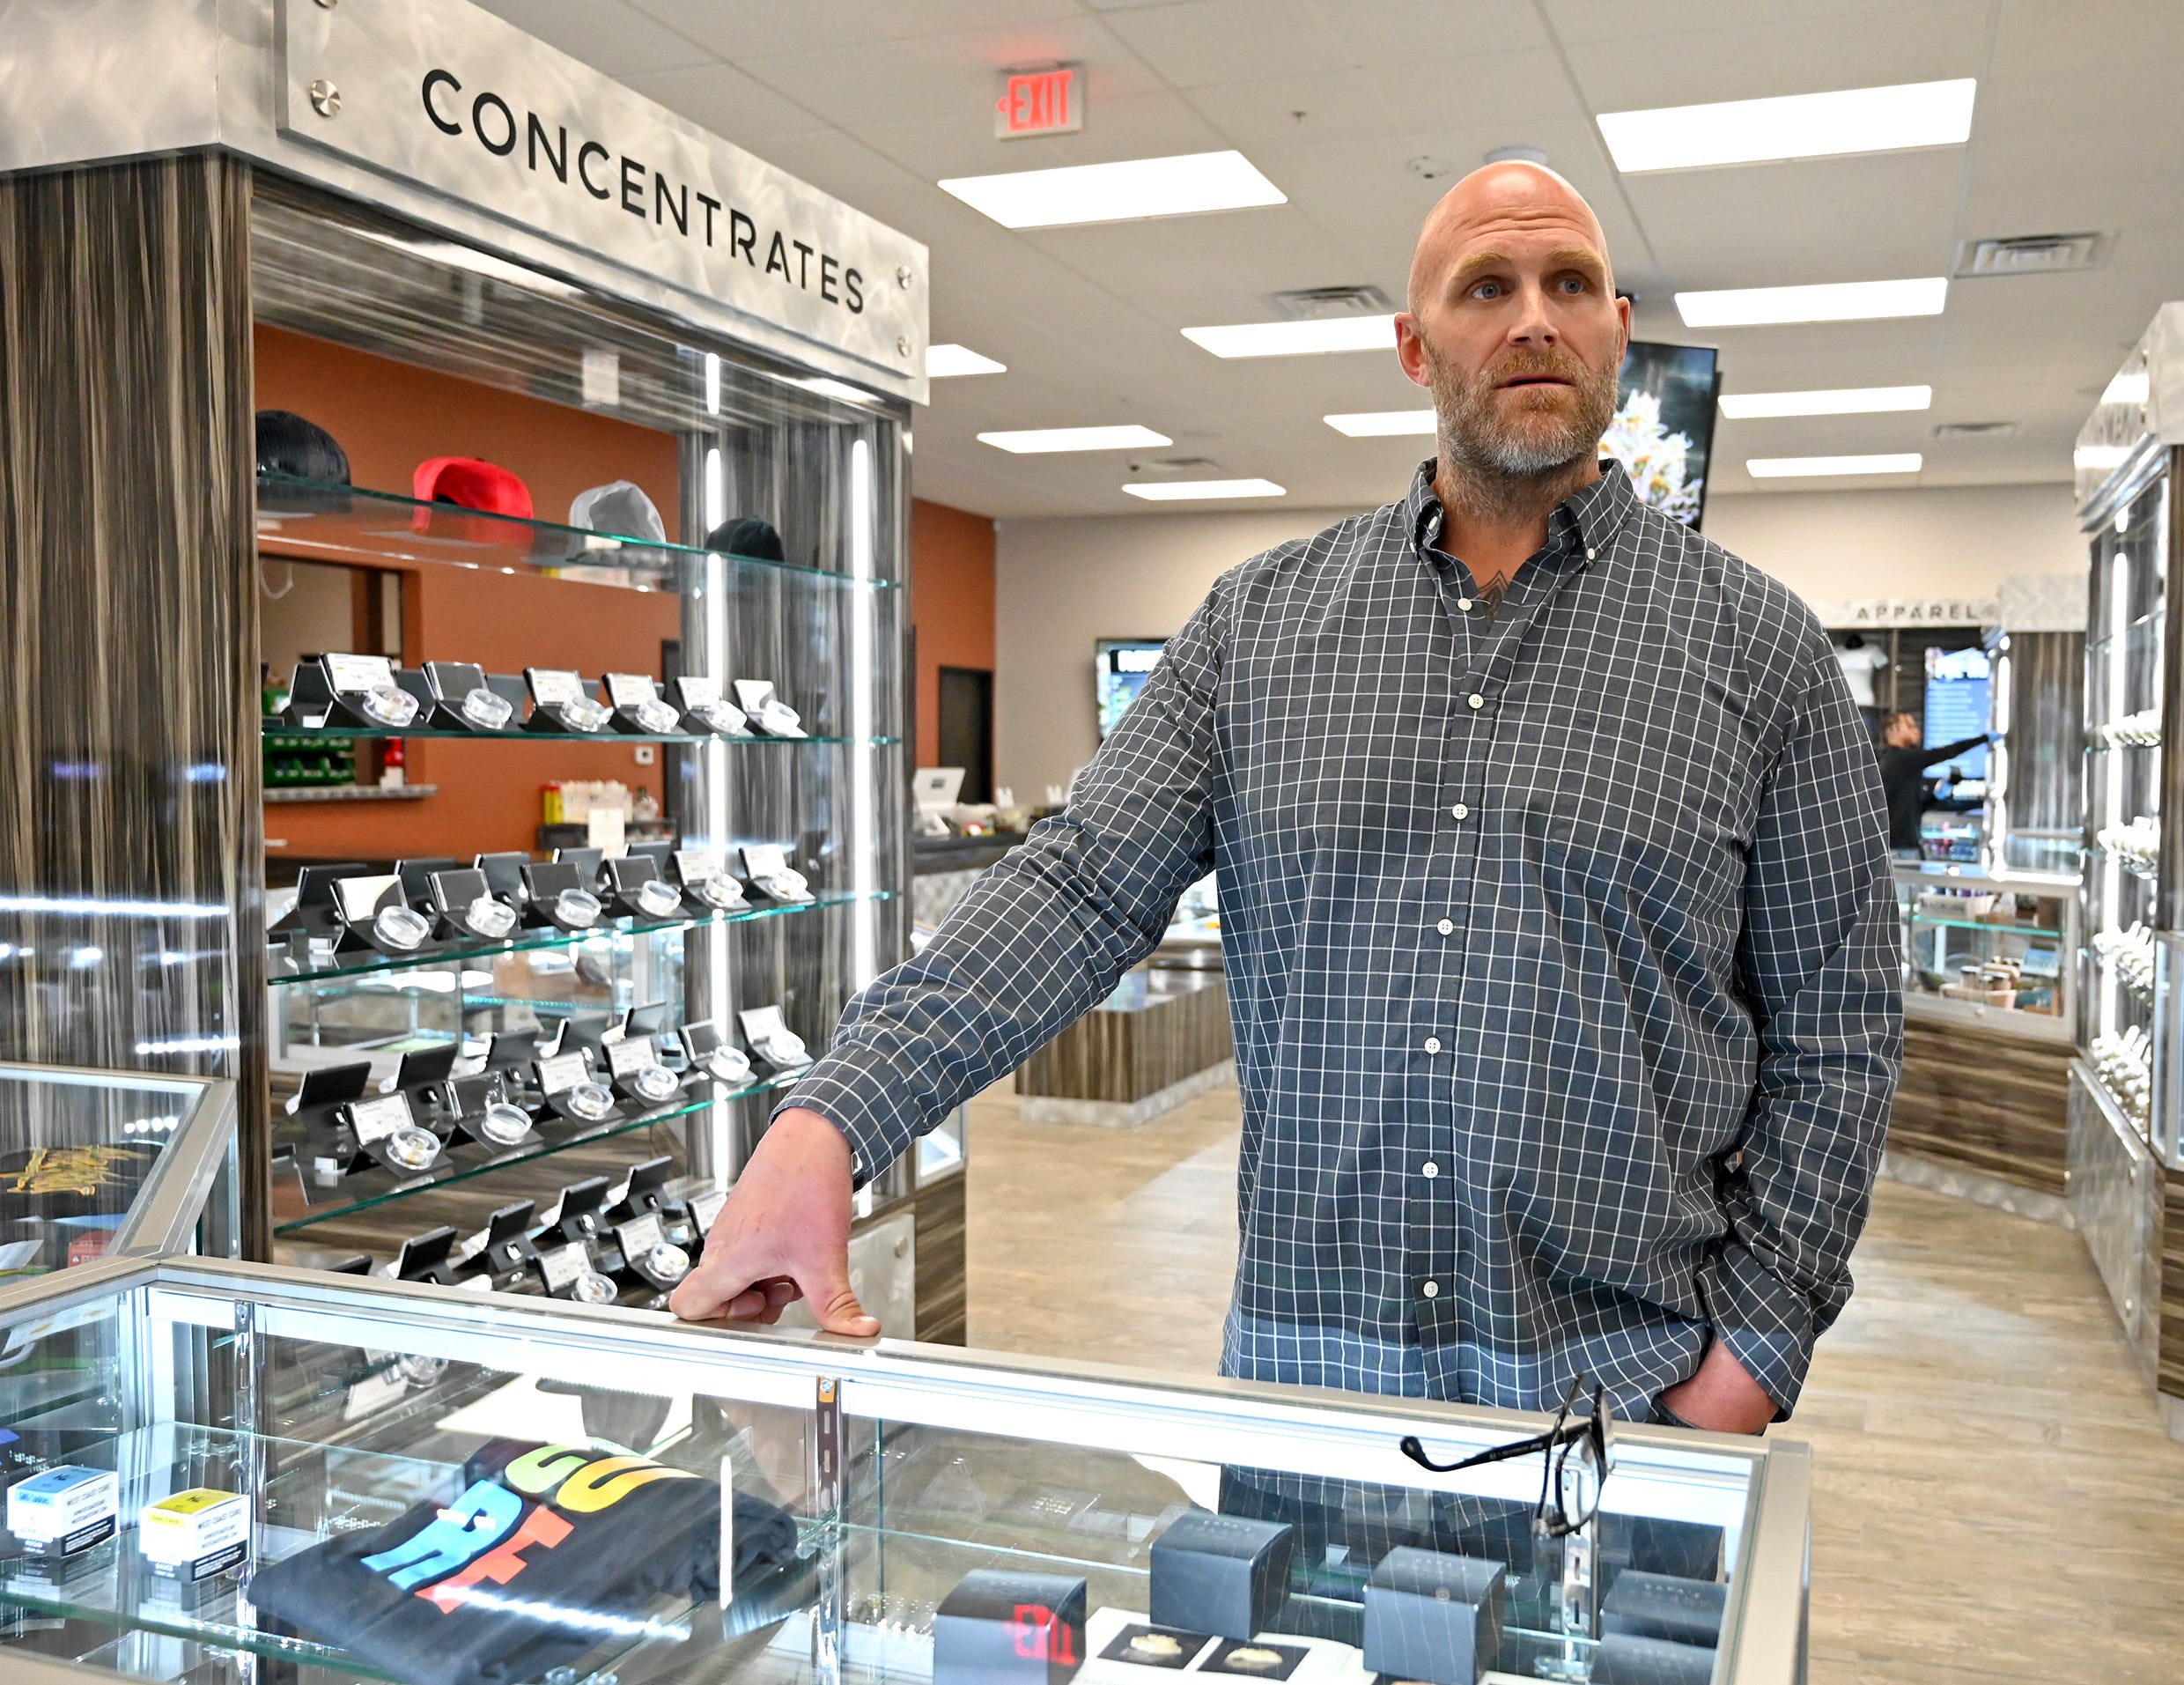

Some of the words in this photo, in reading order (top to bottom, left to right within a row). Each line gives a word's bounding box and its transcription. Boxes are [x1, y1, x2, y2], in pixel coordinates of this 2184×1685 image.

[1007, 70, 1074, 132] EXIT
[421, 69, 866, 314] CONCENTRATES
[1856, 604, 1980, 620] APPAREL
